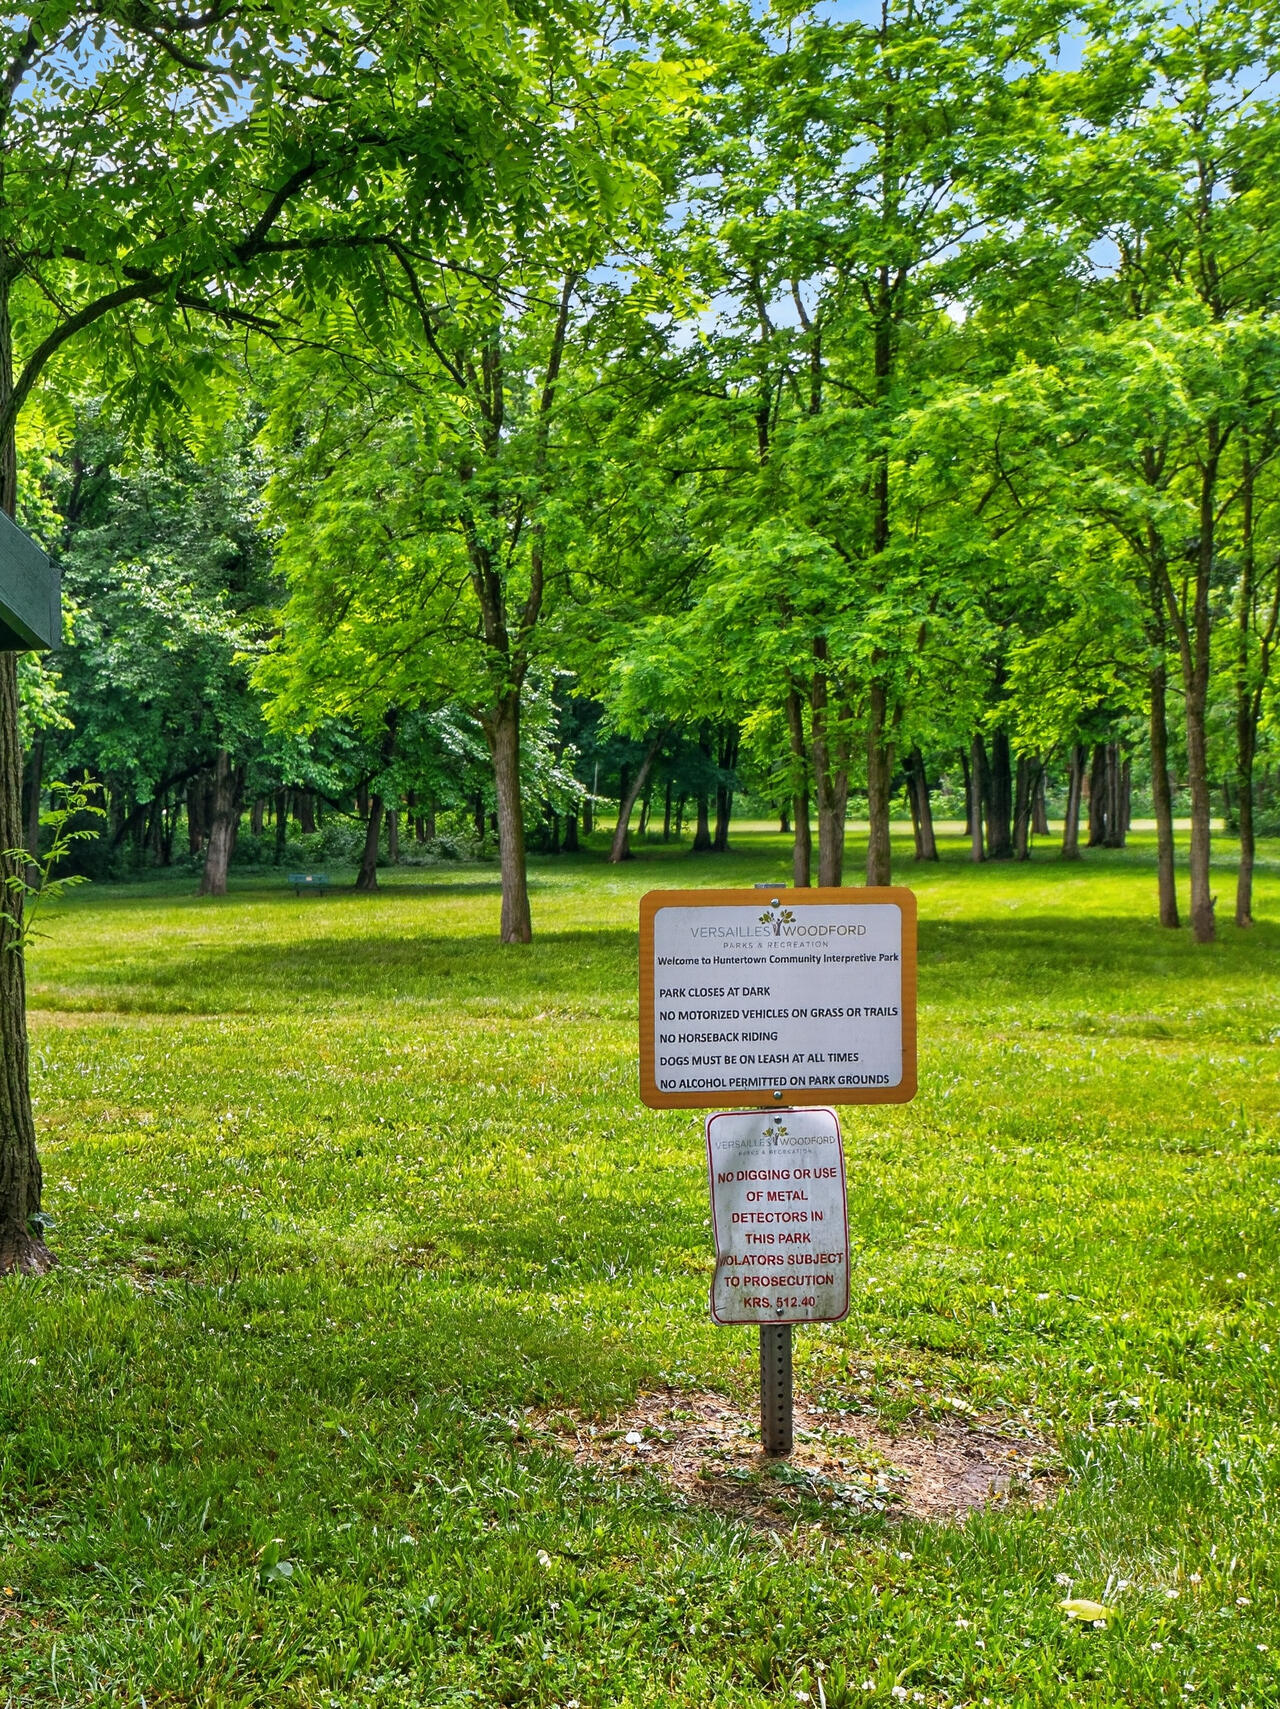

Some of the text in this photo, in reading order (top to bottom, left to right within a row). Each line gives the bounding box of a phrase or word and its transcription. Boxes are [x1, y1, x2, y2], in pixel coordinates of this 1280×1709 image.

[691, 925, 867, 938] VERSAILLES WOODFORD
[658, 953, 899, 966] Welcome to Huntertown Community Interpretive Park
[659, 987, 771, 998] PARK CLOSES AT DARK
[659, 1007, 898, 1021] NO MOTORIZED VEHICLES ON GRASS OR TRAILS
[659, 1031, 778, 1044] NO HORSEBACK RIDING
[660, 1052, 859, 1066] DOGS MUST BE ON LEASH AT ALL TIMES
[660, 1074, 890, 1089] NO ALCOHOL PERMITTED ON PARK GROUNDS
[715, 1135, 836, 1150] VERSAILLES WOODFORD
[718, 1168, 837, 1184] NO DIGGING OR USE
[746, 1190, 808, 1201] OF METAL
[732, 1211, 824, 1223] DETECTORS IN
[745, 1233, 811, 1244] THIS PARK
[787, 1252, 843, 1265] SUBJECT
[724, 1275, 834, 1287] TO PROSECUTION
[744, 1296, 815, 1308] KRS. 512.40
